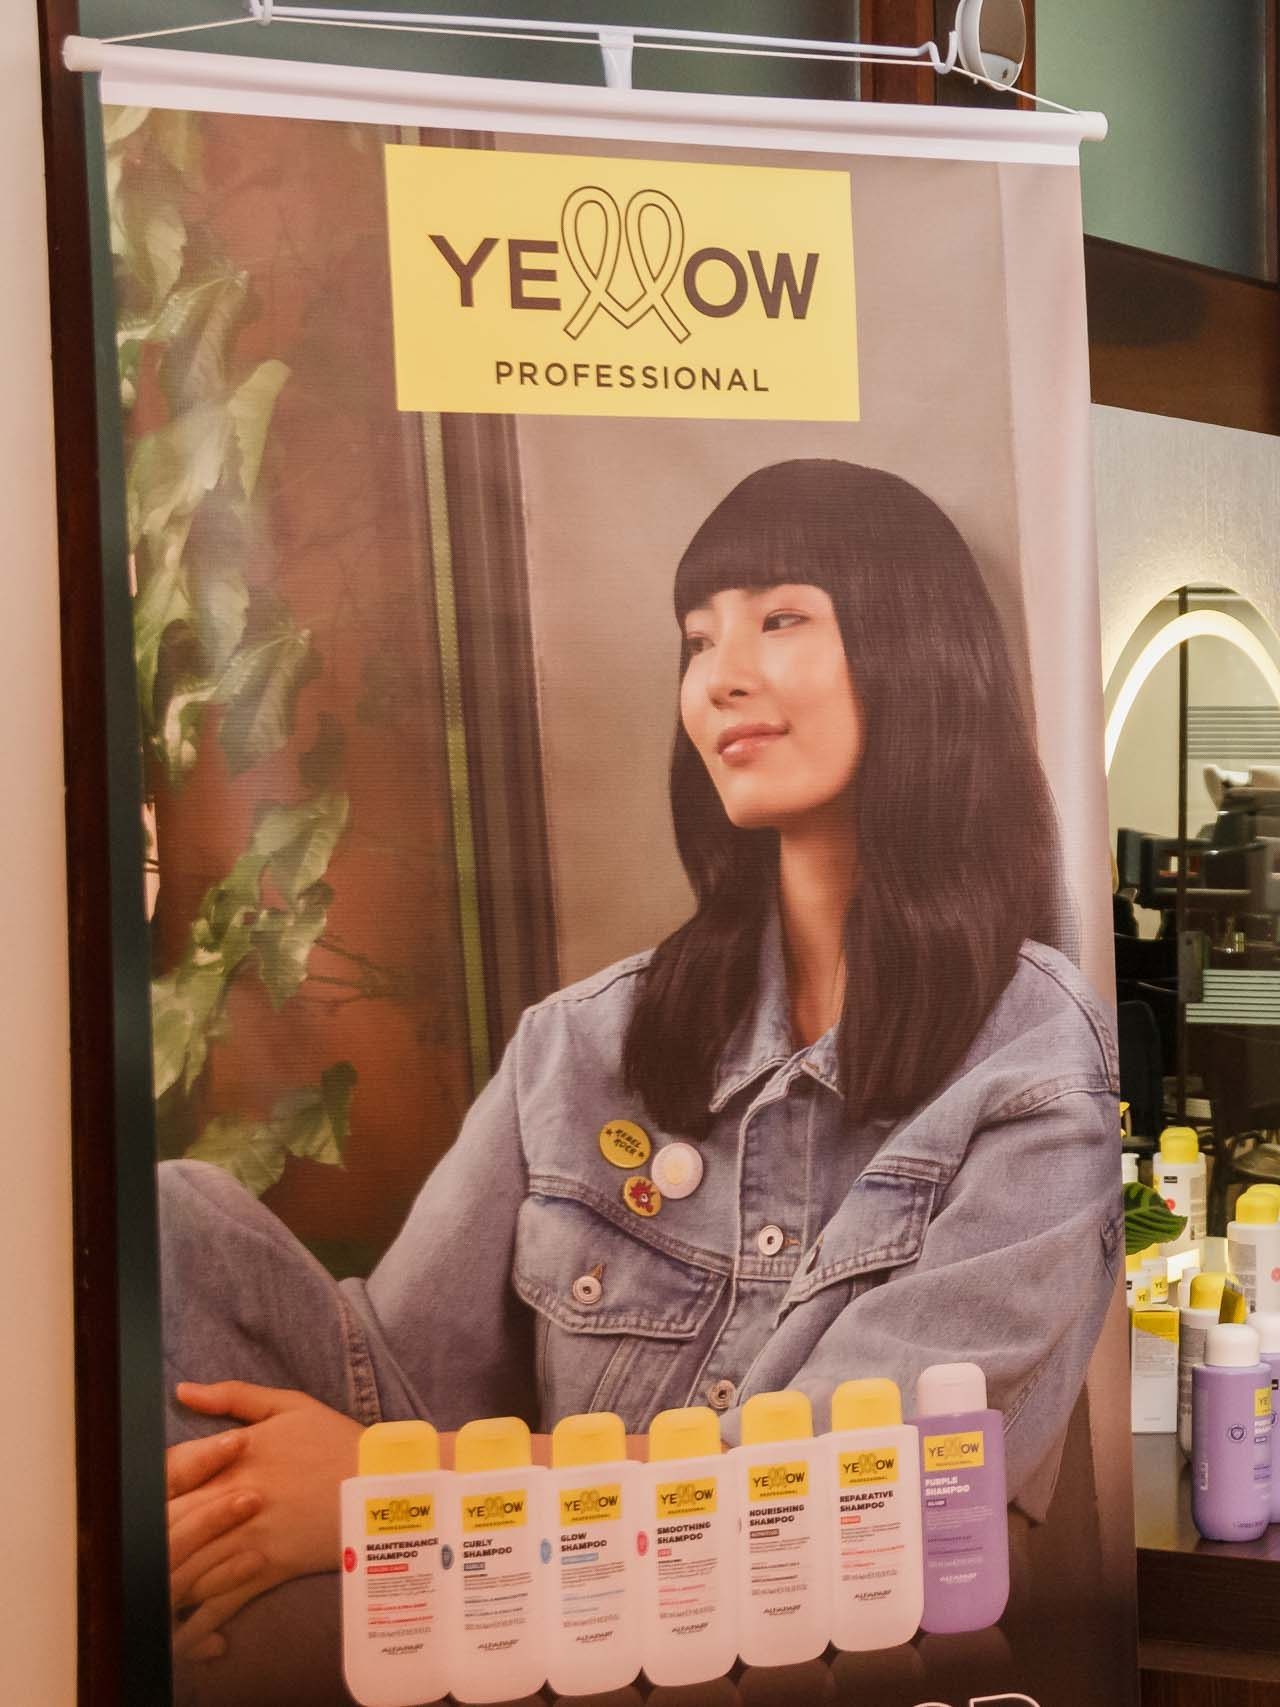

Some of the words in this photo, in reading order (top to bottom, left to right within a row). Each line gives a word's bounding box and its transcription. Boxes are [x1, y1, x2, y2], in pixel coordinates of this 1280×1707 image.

[496, 361, 769, 393] PROFESSIONAL
[840, 1490, 894, 1503] REPARATIVE
[749, 1504, 805, 1517] NOURISHING
[840, 1501, 885, 1512] SHAMPOO
[750, 1515, 795, 1526] SHAMPOO
[657, 1521, 712, 1535] SMOOTHING
[561, 1532, 588, 1542] GLOW
[657, 1533, 704, 1544] SHAMPOO
[366, 1537, 439, 1551] MAINTENANCE
[463, 1539, 493, 1549] CURLY
[561, 1540, 607, 1552] SHAMPOO
[366, 1551, 418, 1562] SHAMPOO
[463, 1547, 512, 1558] SHAMPOO
